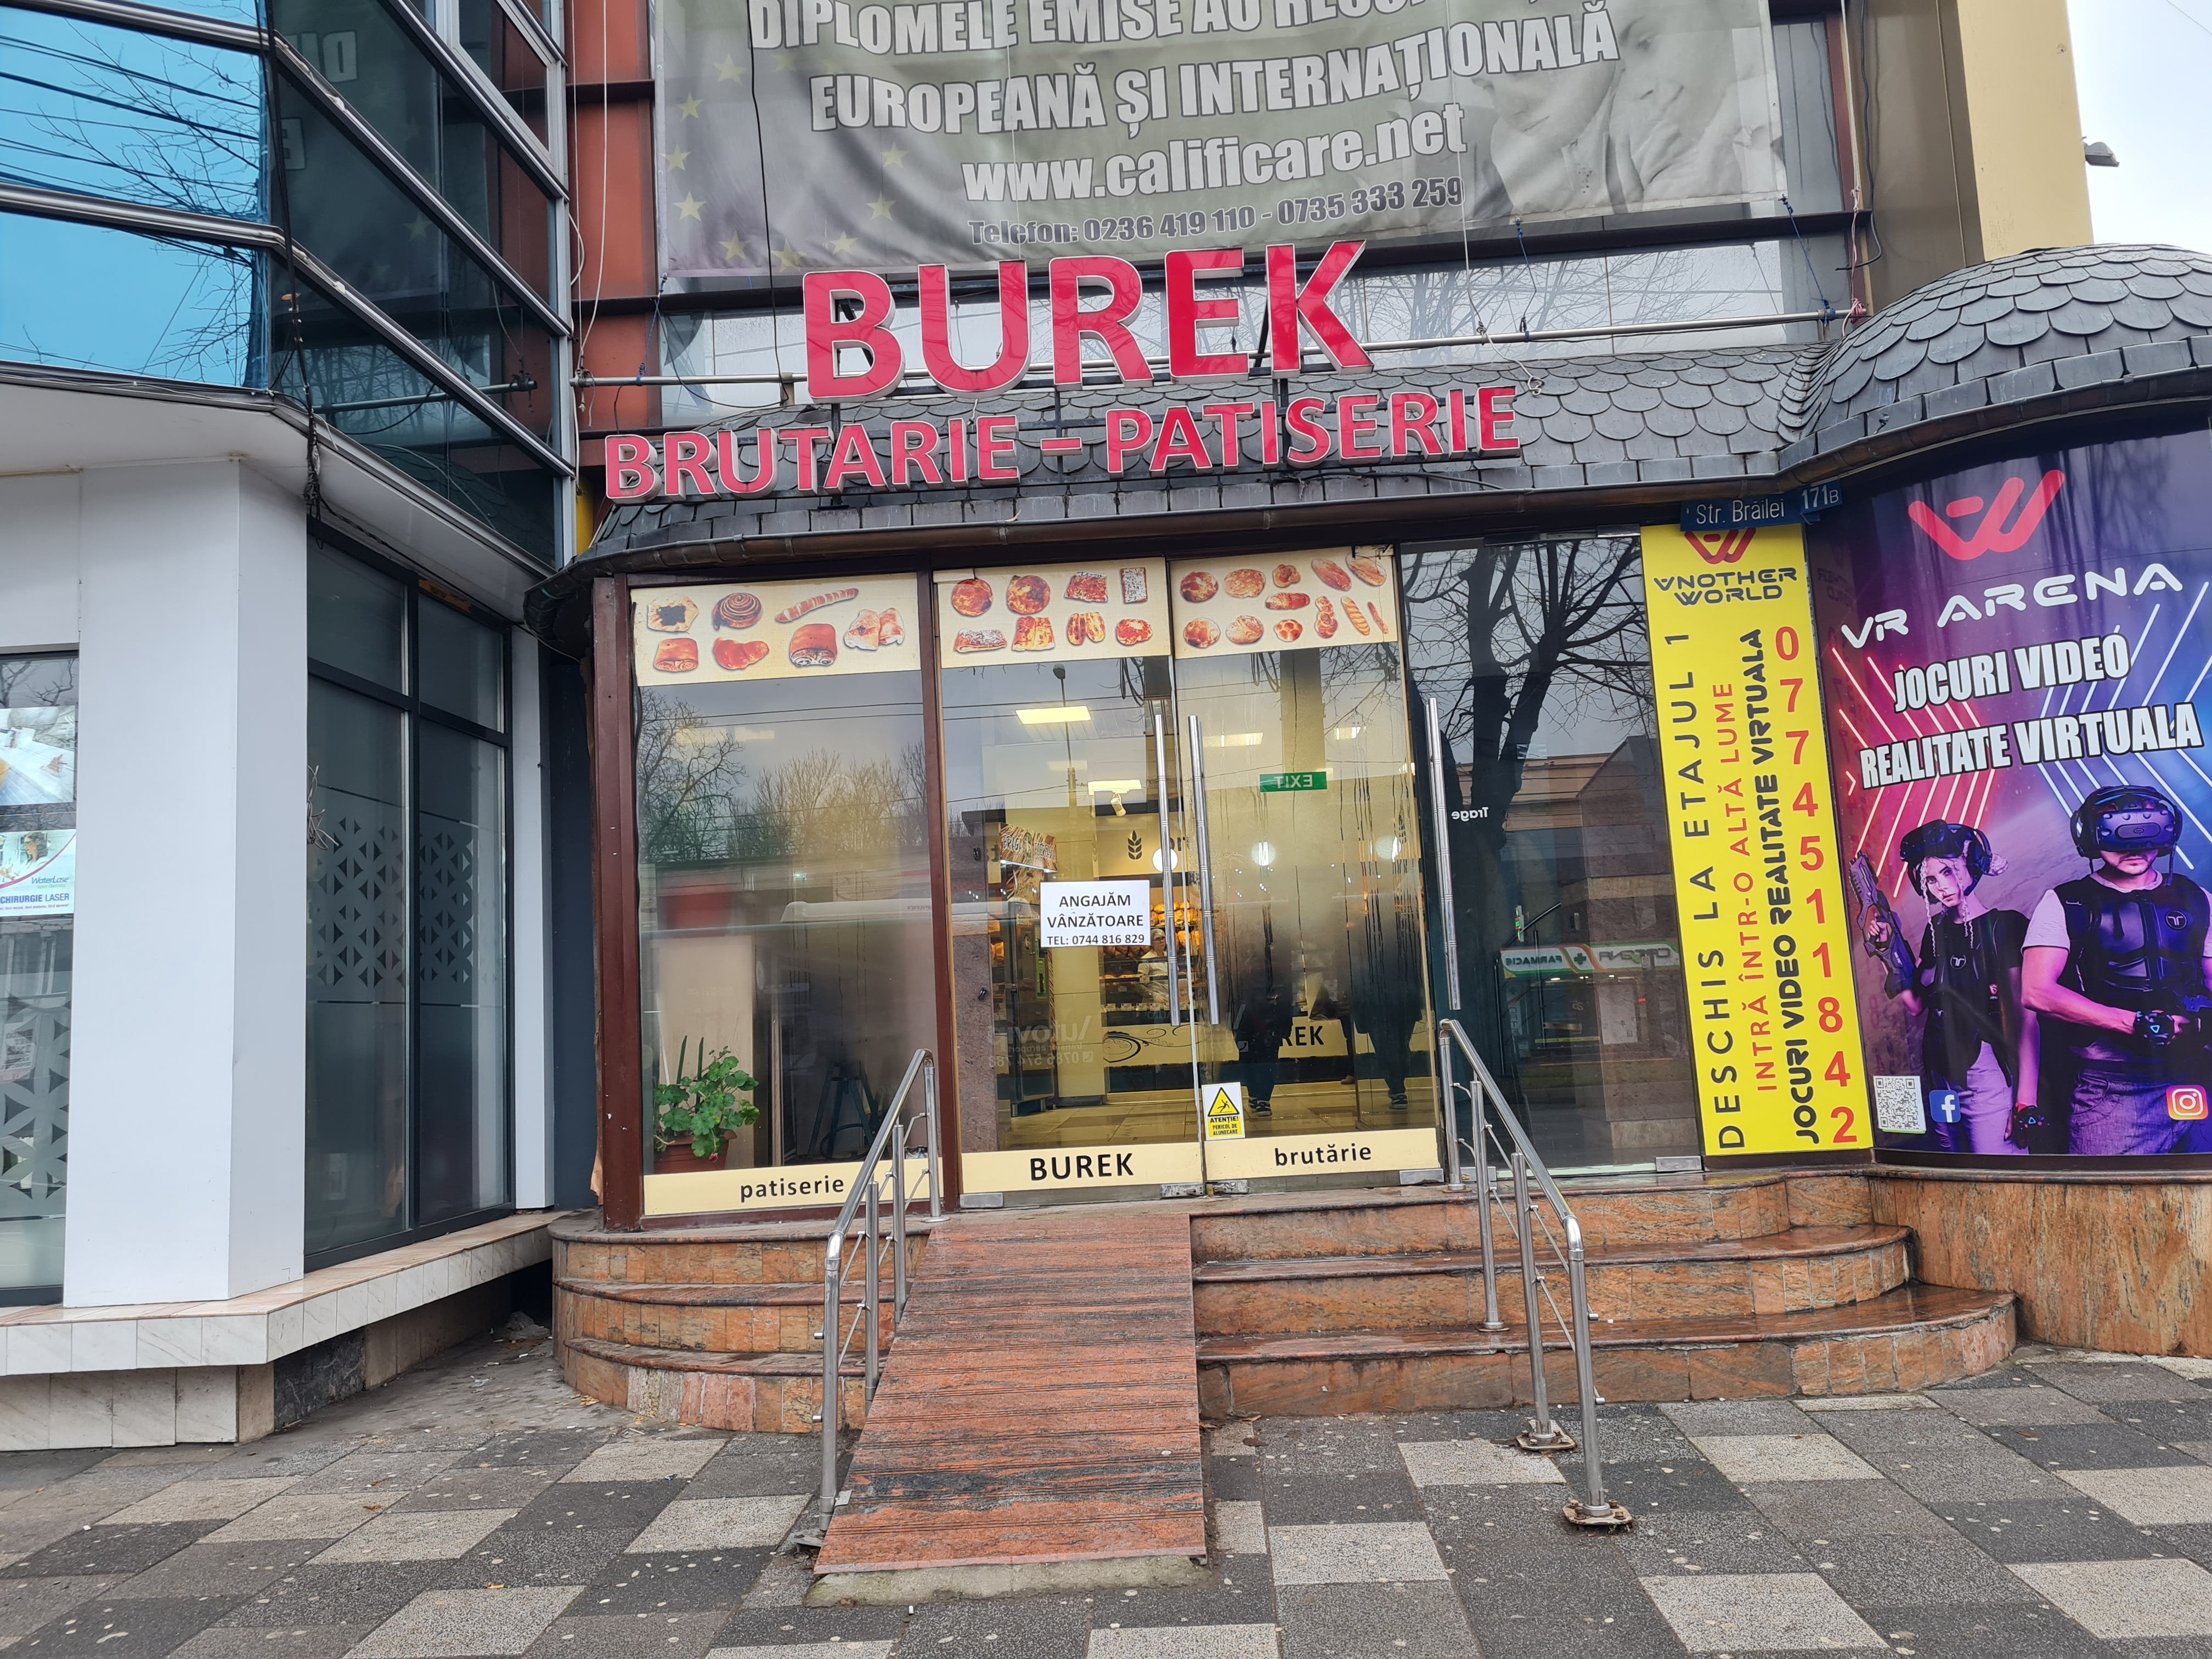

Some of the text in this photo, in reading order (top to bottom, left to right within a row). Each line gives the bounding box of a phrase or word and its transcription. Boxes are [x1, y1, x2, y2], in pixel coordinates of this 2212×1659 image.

[748, 0, 1019, 55] DIPLOMELE
[1028, 0, 1183, 44] EMISE
[1191, 0, 1262, 33] AU
[809, 63, 1108, 134] EUROPEANĂ
[1115, 67, 1168, 139] ȘI
[1178, 0, 1620, 117] INTERNAȚIONALĂ
[961, 103, 1468, 201] www.calificare.net
[968, 176, 1465, 245] Telefon: 0236 419 110 - 0735 333 259
[803, 240, 1374, 404] BUREK
[603, 414, 1022, 505] BRUTARIE
[1104, 385, 1521, 478] PATISERIE
[1696, 488, 1839, 524] Str. Brăilei 171B
[1674, 585, 1783, 605] WORLD
[1841, 563, 2183, 648] VR ARENA
[1893, 633, 2131, 713] JOCURI VIDEO
[1860, 701, 2203, 789] REALITATE VIRTUALA
[0, 893, 69, 904] CHIRURGIE LASER
[1047, 912, 1144, 928] VÂNZĂTOARE
[1059, 891, 1131, 907] ANGAJĂM
[1664, 634, 1745, 1149] DESCHIS LA ETAJUL 1
[1712, 683, 1778, 1091] INTRĂ ÎNTR-O ALTĂ LUME
[1740, 628, 1820, 1144] JOCURI VIDEO REALITATE VIRTUALA
[1047, 934, 1144, 945] TEL: 0744 816 829
[740, 1175, 845, 1203] patiserie
[1030, 1153, 1134, 1182] BUREK
[1274, 1142, 1372, 1167] brutărie
